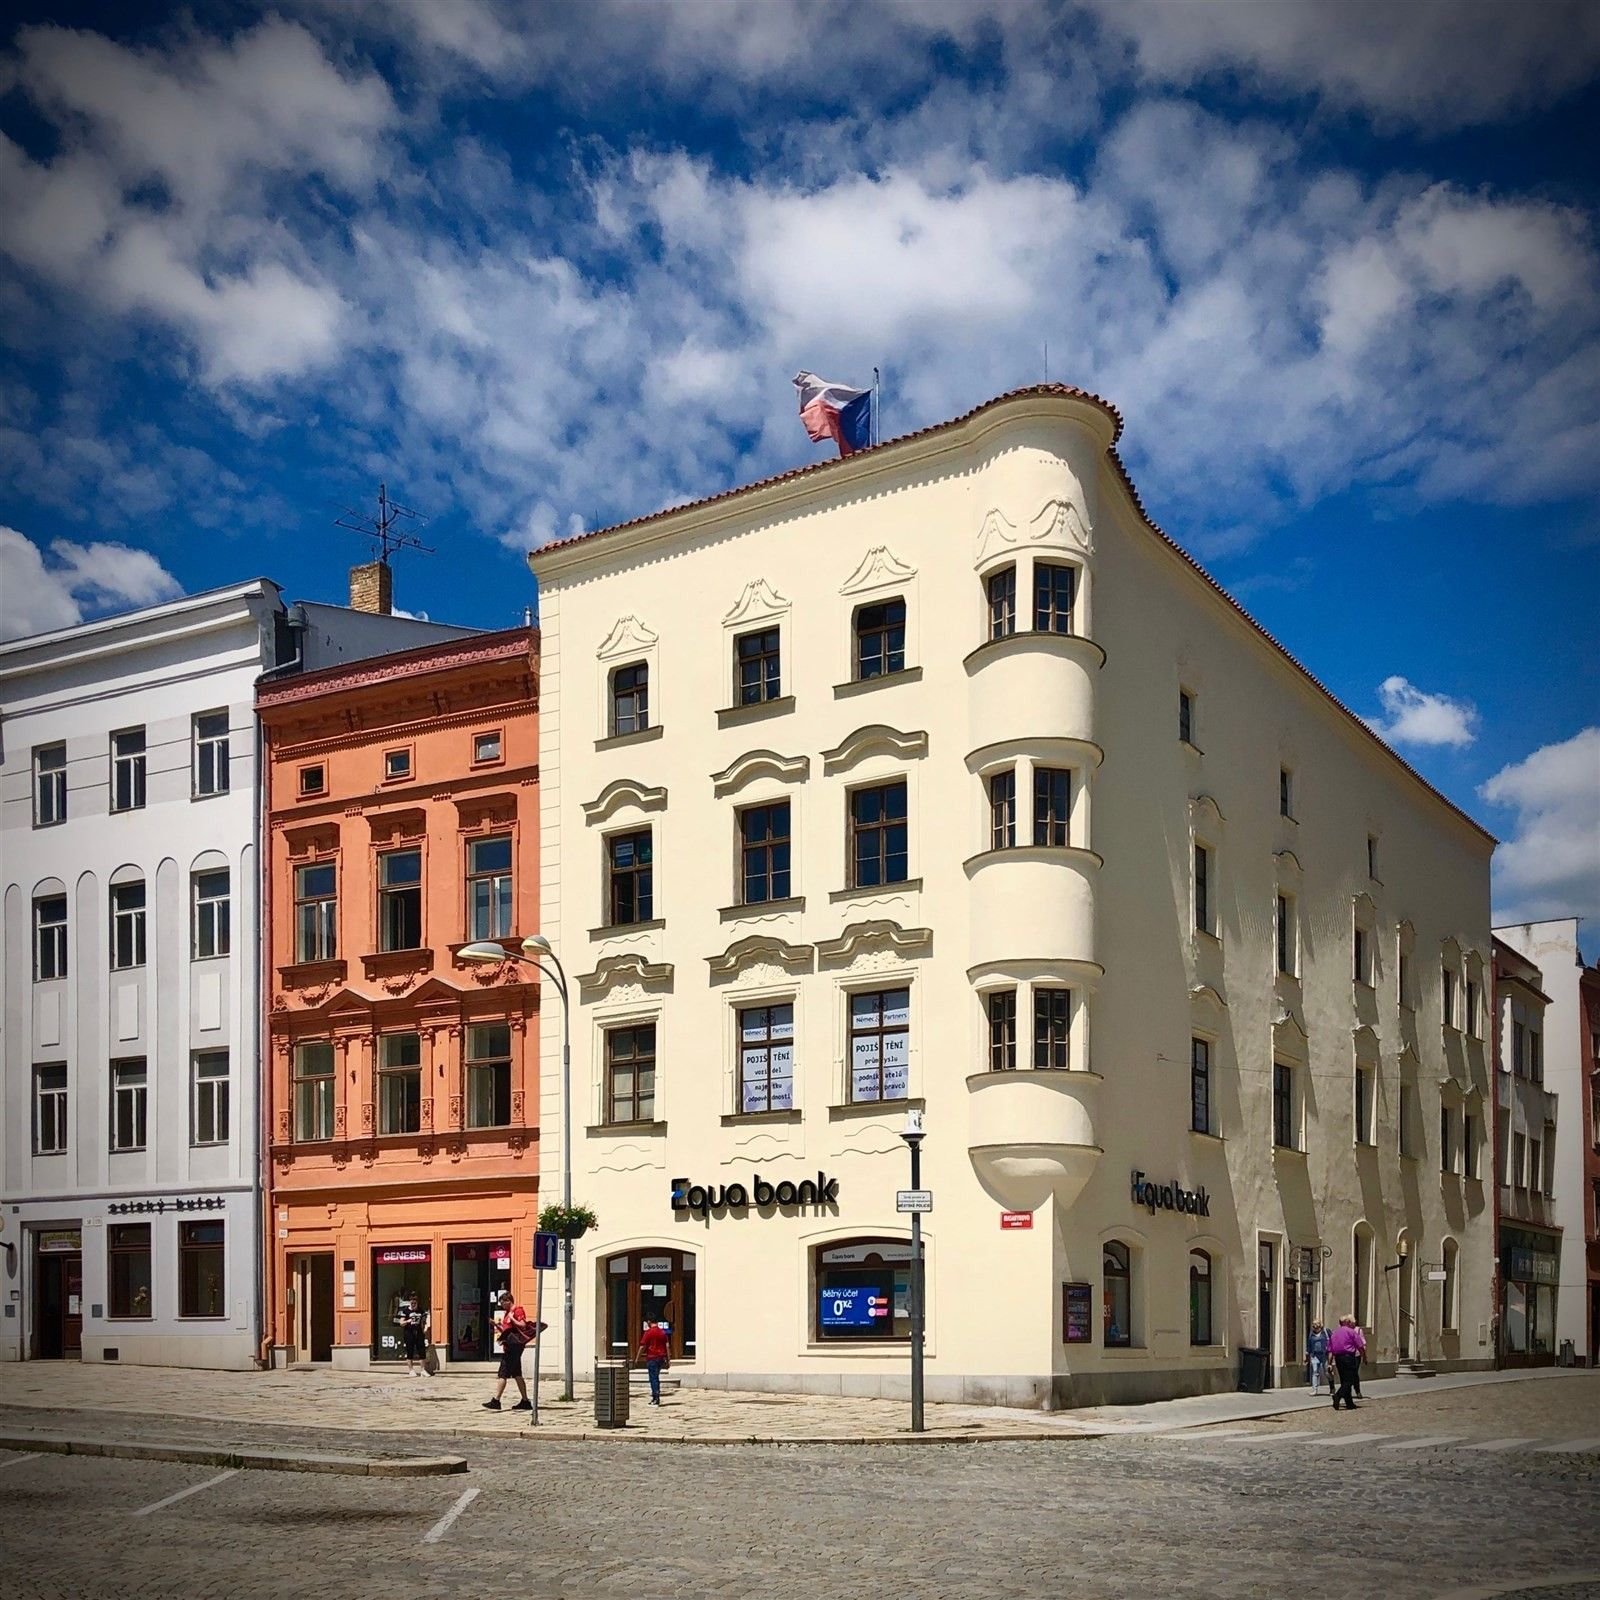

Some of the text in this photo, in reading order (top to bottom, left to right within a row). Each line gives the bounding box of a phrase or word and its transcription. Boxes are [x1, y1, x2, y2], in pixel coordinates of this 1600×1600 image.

[884, 1013, 907, 1021] Partners
[745, 1029, 762, 1037] Němec
[671, 1171, 837, 1216] Equa bank
[1132, 1171, 1210, 1217] Equa bank
[383, 1250, 427, 1262] GENESIS
[823, 1288, 859, 1299] Běžný účet
